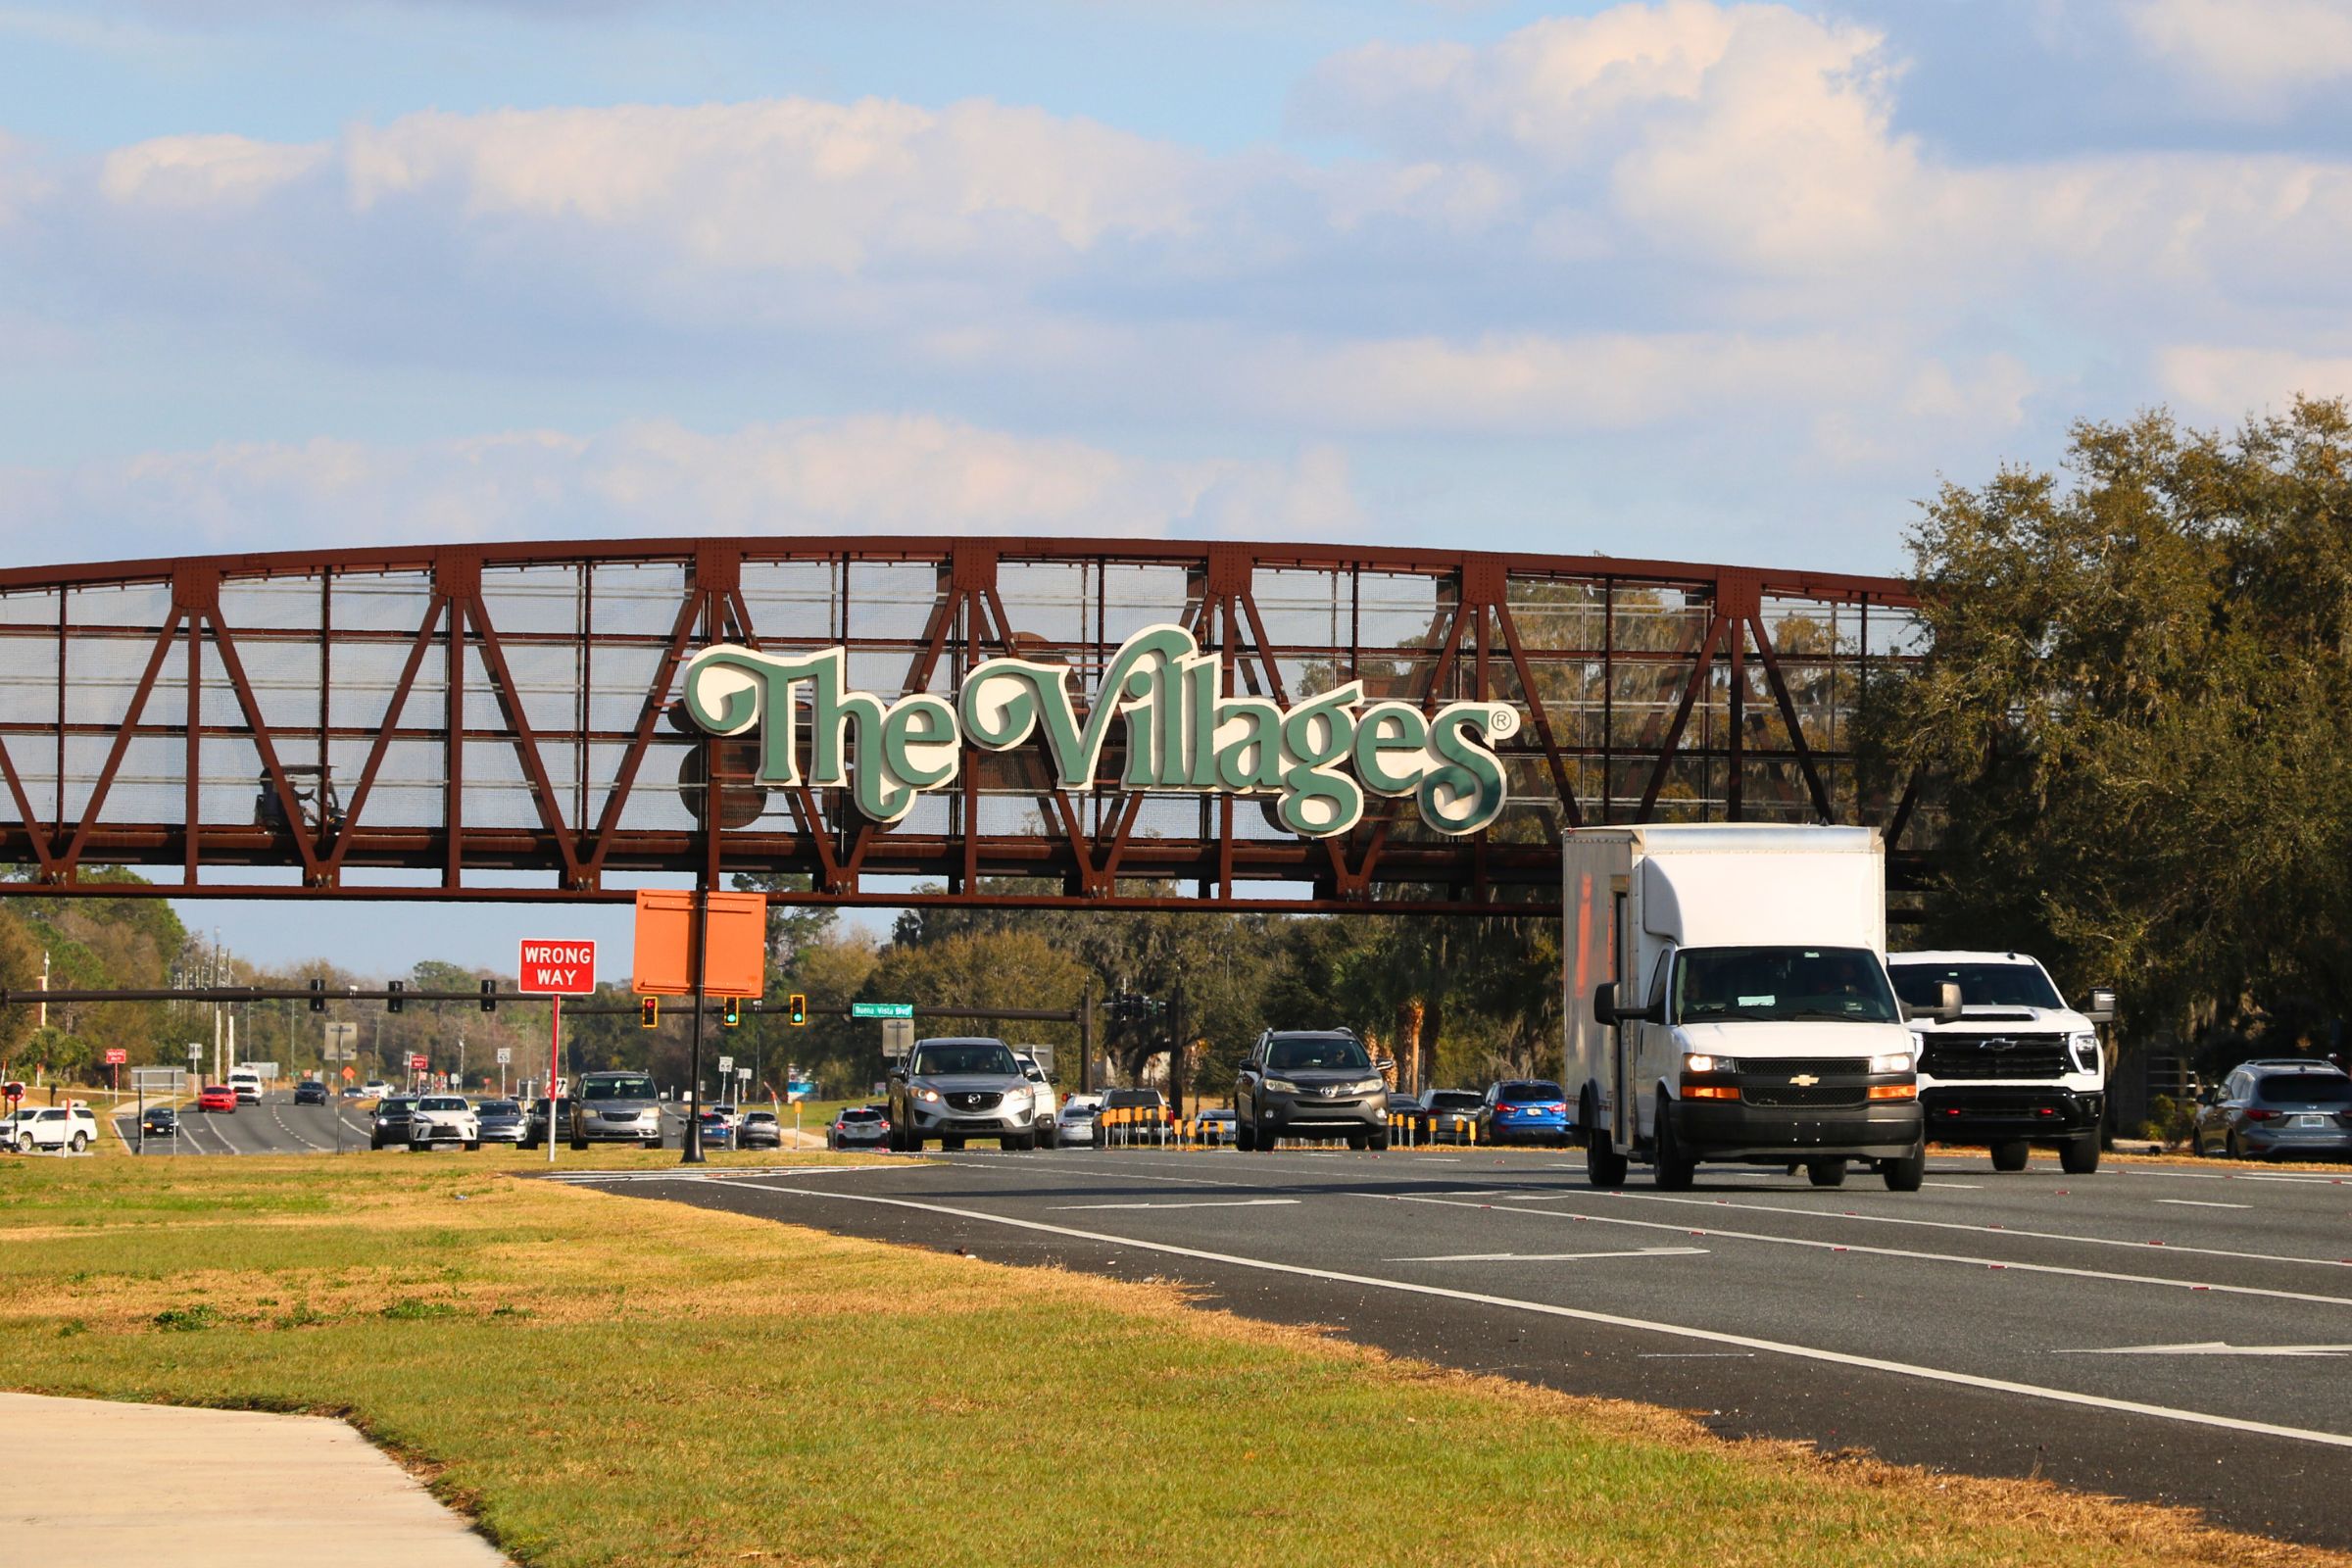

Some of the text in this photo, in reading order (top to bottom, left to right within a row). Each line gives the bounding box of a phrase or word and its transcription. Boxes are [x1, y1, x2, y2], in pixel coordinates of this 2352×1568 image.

[685, 647, 959, 821] The
[524, 947, 591, 964] WRONG
[536, 968, 577, 986] WAY
[855, 1005, 911, 1016] Buena Vista Blvd
